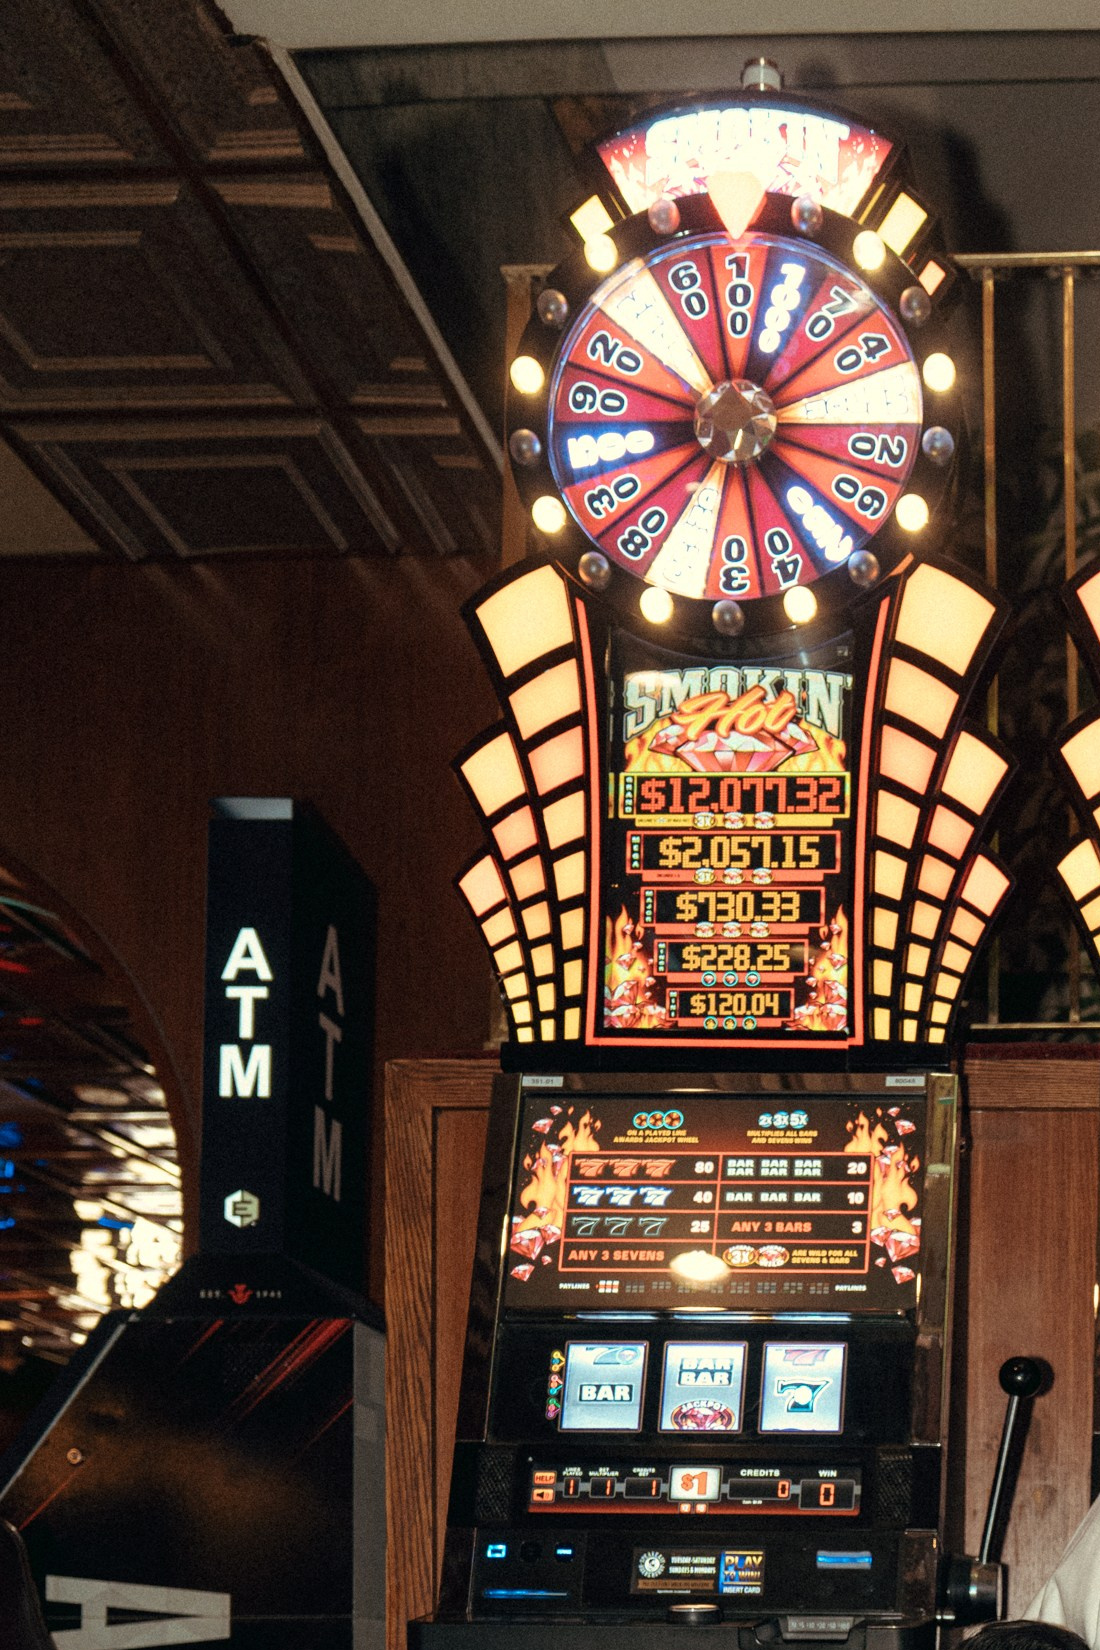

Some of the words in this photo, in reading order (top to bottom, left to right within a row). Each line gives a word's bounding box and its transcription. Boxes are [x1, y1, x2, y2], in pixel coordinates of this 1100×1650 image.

[668, 262, 708, 320] 60
[724, 252, 752, 338] 100
[806, 287, 856, 341] 70
[586, 330, 643, 377] 20
[834, 332, 891, 374] 40
[849, 432, 907, 467] 20
[585, 474, 641, 517] 30
[617, 505, 668, 560] 80
[718, 536, 750, 594] 30
[765, 529, 801, 590] 40
[672, 685, 799, 740] Hot
[640, 777, 841, 813] $12,077.32
[659, 835, 820, 869] $2,057.15
[675, 891, 800, 922] $730.33
[681, 944, 791, 971] $228.25
[219, 927, 274, 1098] ATM
[690, 992, 780, 1016] $120.04
[313, 923, 345, 1202] ATM
[773, 1113, 790, 1128] 3X
[790, 1112, 809, 1127] 5X
[694, 1161, 714, 1174] 80
[727, 1159, 754, 1168] BAR
[761, 1159, 788, 1168] BAR
[794, 1159, 821, 1168] BAR
[727, 1168, 754, 1177] BAR
[760, 1168, 787, 1177] BAR
[794, 1168, 821, 1177] BAR
[847, 1162, 867, 1175] 20
[693, 1191, 713, 1203] 40
[726, 1192, 753, 1202] BAR
[760, 1192, 787, 1202] BAR
[793, 1192, 821, 1202] BAR
[847, 1191, 865, 1204] 10
[572, 1216, 600, 1236] 7
[604, 1216, 633, 1236] 7
[638, 1216, 668, 1236] 7
[690, 1220, 710, 1233] 25
[731, 1221, 761, 1232] ANY
[764, 1221, 773, 1232] 3
[775, 1221, 812, 1232] BARS
[851, 1221, 863, 1234] 3
[568, 1250, 598, 1261] ANY
[601, 1250, 610, 1261] 3
[613, 1250, 665, 1261] SEVENS
[682, 1358, 731, 1371] BAR
[680, 1371, 731, 1385] BAR
[581, 1386, 631, 1401] BAR
[777, 1379, 830, 1413] 7
[681, 1400, 727, 1413] JACKPOT
[535, 1474, 554, 1482] HELP
[681, 1471, 708, 1496] $1
[740, 1469, 781, 1477] CREDITS
[777, 1480, 790, 1498] 0
[819, 1483, 835, 1506] 0
[725, 1555, 763, 1567] PLAY
